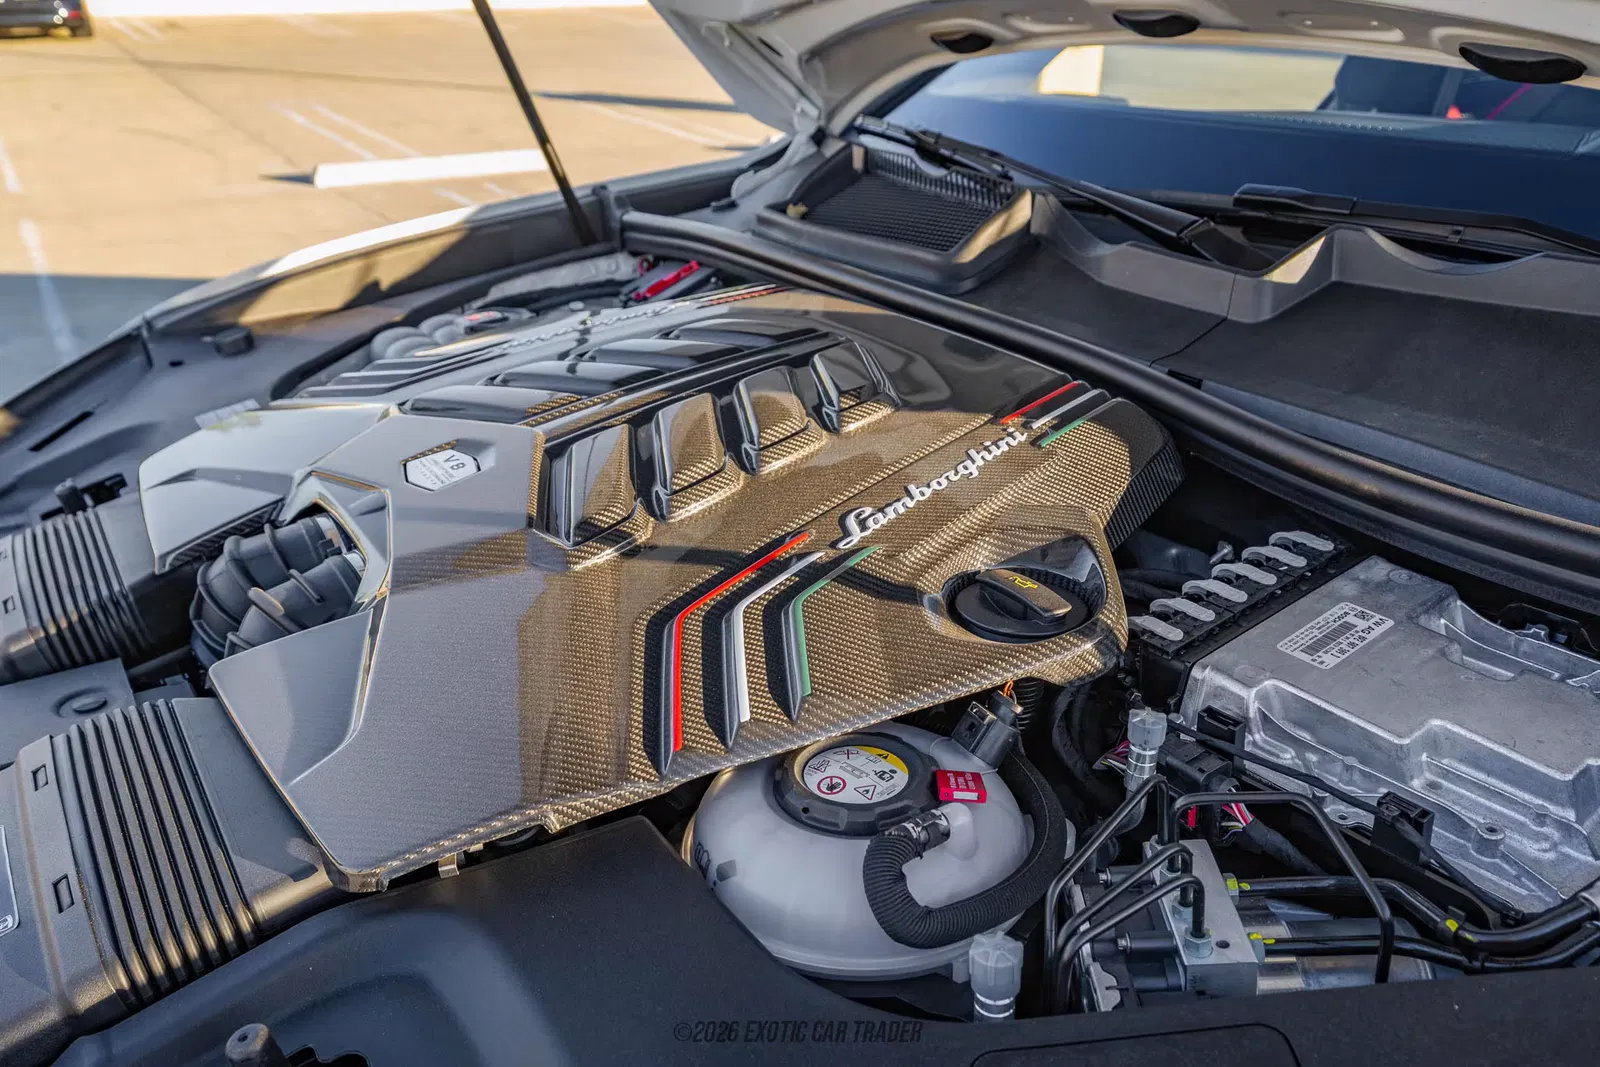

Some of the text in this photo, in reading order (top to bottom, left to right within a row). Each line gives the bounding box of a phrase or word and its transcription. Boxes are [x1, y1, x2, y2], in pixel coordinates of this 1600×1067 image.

[443, 454, 466, 471] V8
[836, 427, 1028, 549] Lamborghini
[1331, 611, 1351, 623] BOSCH
[1373, 617, 1389, 627] VW
[1361, 626, 1375, 635] AG
